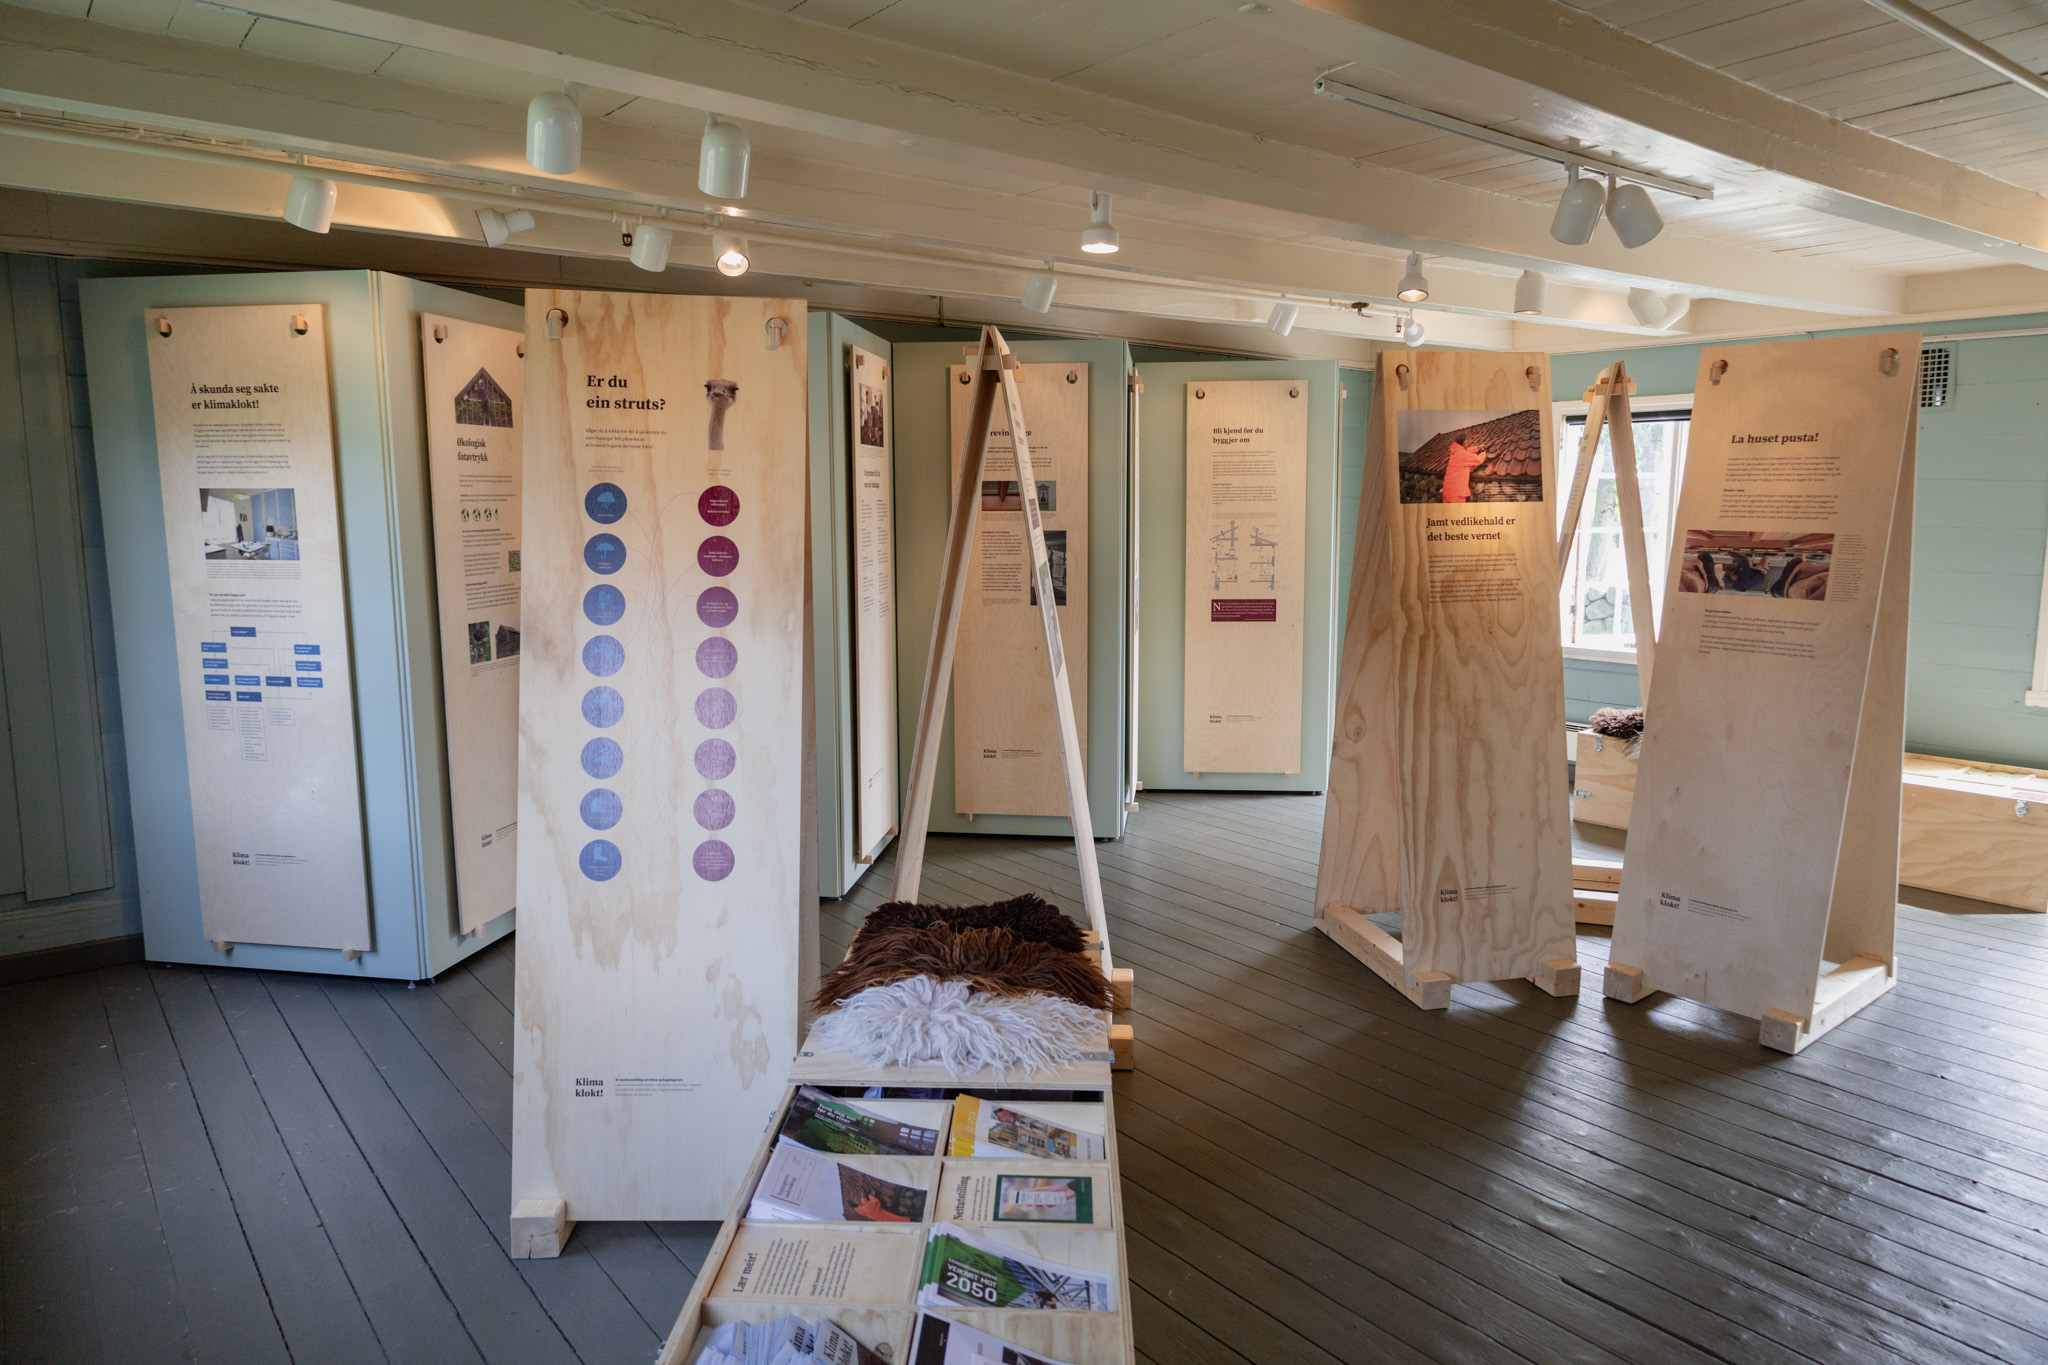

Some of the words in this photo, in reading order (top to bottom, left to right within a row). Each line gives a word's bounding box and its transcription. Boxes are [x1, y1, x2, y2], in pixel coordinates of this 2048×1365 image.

[586, 375, 604, 388] Er
[608, 375, 628, 388] du
[190, 382, 197, 394] Å
[199, 384, 234, 394] skunda
[236, 386, 252, 396] seg
[253, 384, 279, 393] sakte
[204, 400, 260, 410] klimaklokt!
[586, 396, 610, 409] ein
[614, 397, 666, 410] struts?
[457, 437, 486, 449] Økologisk
[1731, 435, 1744, 444] La
[1747, 433, 1779, 444] huset
[1781, 433, 1819, 445] pusta!
[458, 452, 488, 463] fotavtrykk
[1426, 517, 1449, 528] Jamt
[1451, 516, 1504, 526] vedlikehald
[1427, 532, 1442, 541] det
[1444, 532, 1469, 540] beste
[1661, 892, 1680, 902] Klima
[1660, 899, 1679, 909] klokt!
[576, 1078, 604, 1086] Klima
[575, 1089, 603, 1097] klokt!
[953, 1176, 971, 1220] Nettutstilling
[732, 1276, 748, 1293] Lær
[743, 1253, 758, 1274] meir!
[947, 1263, 978, 1281] VEIKART
[980, 1277, 997, 1287] MOT
[946, 1272, 997, 1302] 2050
[823, 1330, 840, 1361] Klima
